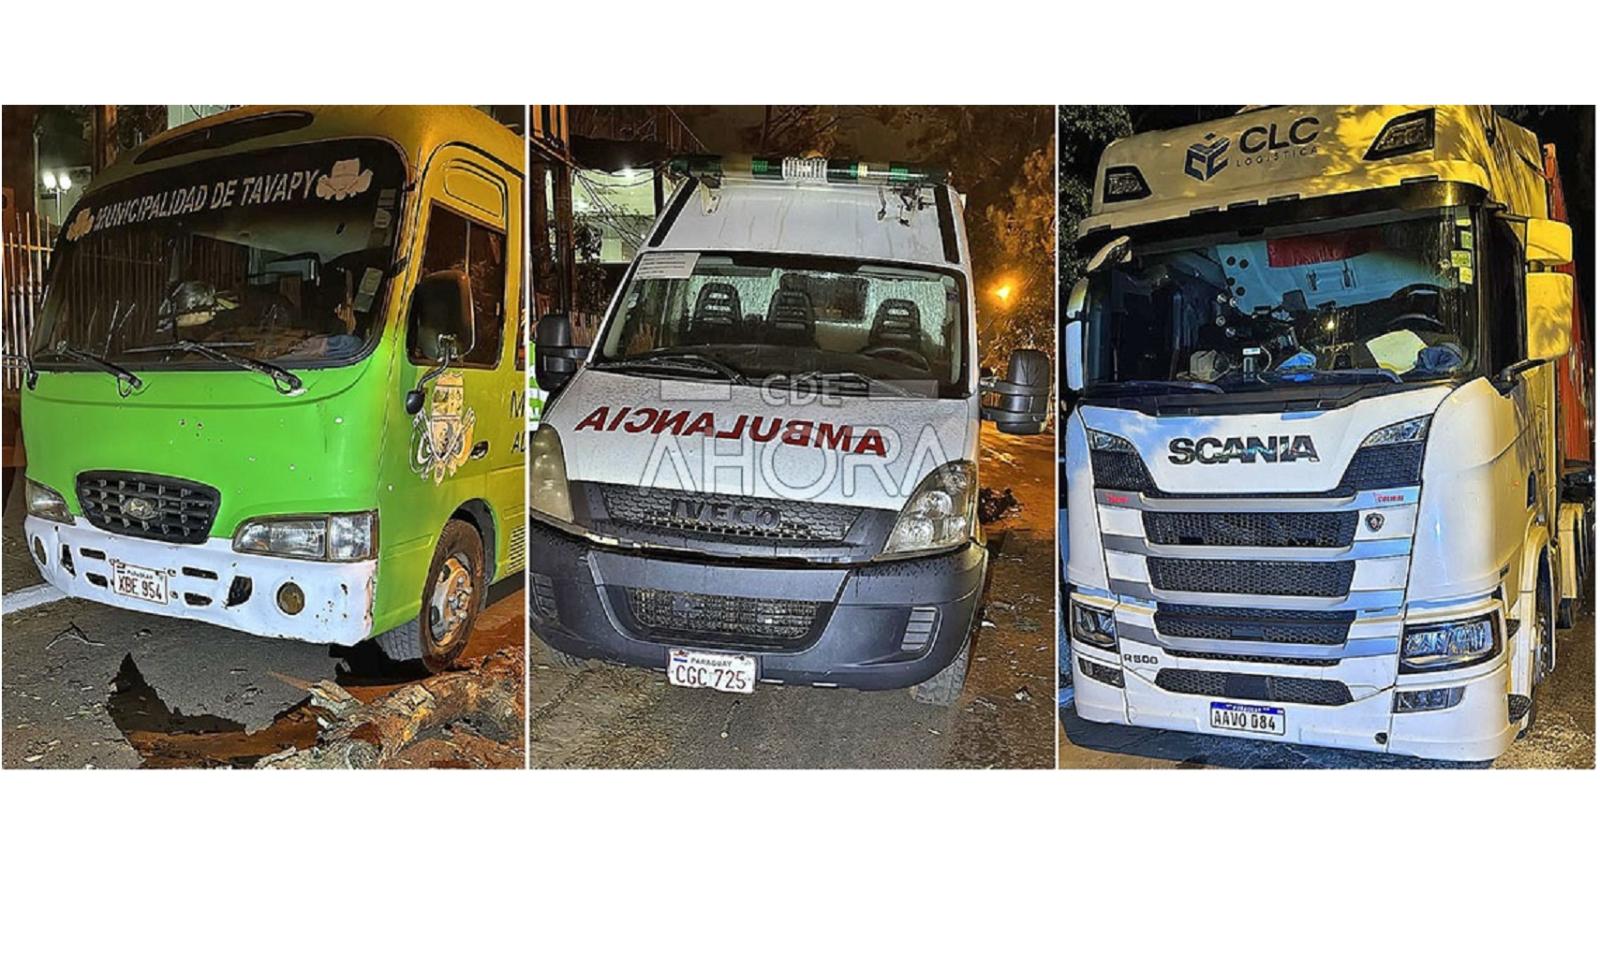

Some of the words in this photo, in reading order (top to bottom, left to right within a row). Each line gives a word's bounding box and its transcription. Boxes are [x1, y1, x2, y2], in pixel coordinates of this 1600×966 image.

[1239, 116, 1320, 154] CLC
[93, 184, 205, 232] MUNICIPALIDAD
[210, 179, 238, 210] DE
[240, 169, 319, 207] TAVAPY
[1168, 435, 1320, 465] SCANIA
[671, 499, 780, 530] IVECO
[118, 575, 139, 596] XBE
[142, 580, 162, 600] 954
[675, 664, 708, 686] CGC
[714, 668, 747, 690] 725
[690, 657, 733, 668] PARAGUAY
